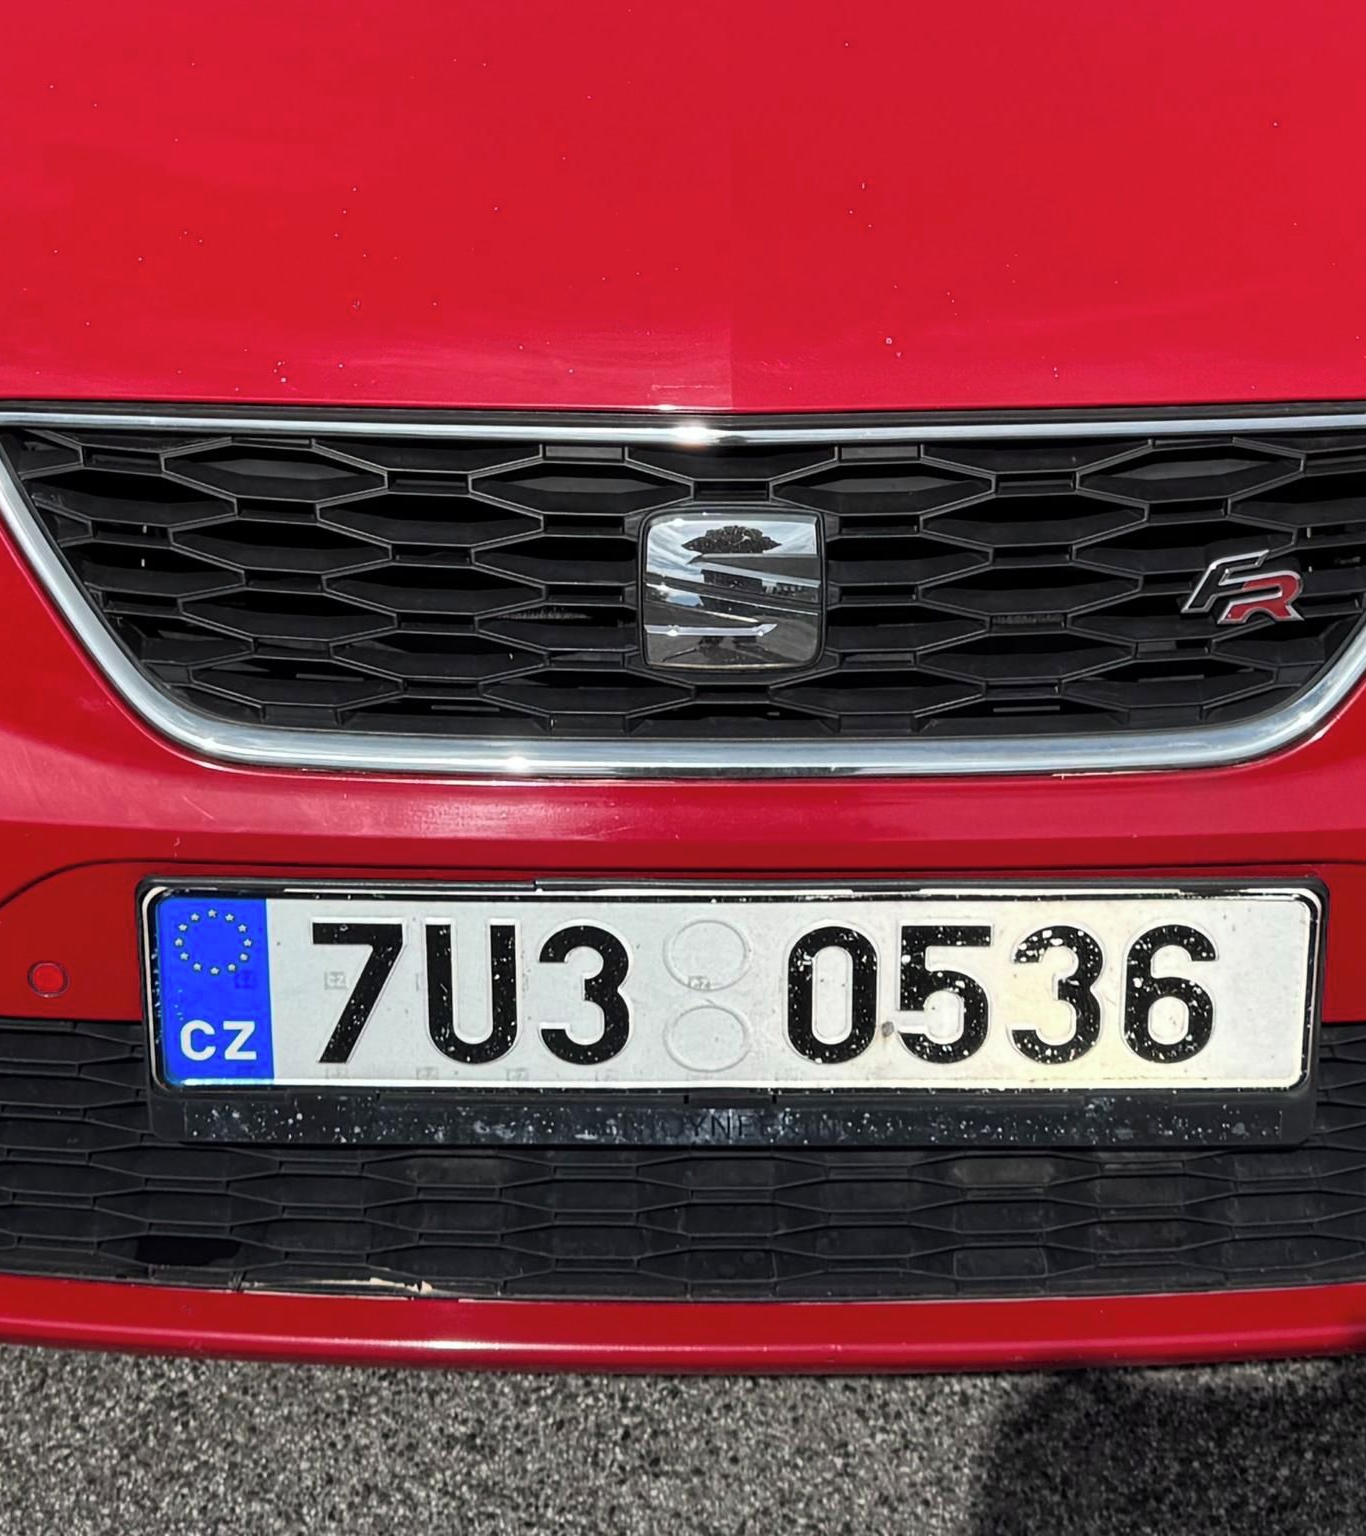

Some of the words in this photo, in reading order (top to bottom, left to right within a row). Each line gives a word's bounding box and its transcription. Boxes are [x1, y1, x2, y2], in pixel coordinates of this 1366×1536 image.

[1180, 549, 1305, 624] FR
[311, 921, 630, 1065] 7U3
[786, 923, 1218, 1065] 0536
[179, 1019, 258, 1062] CZ
